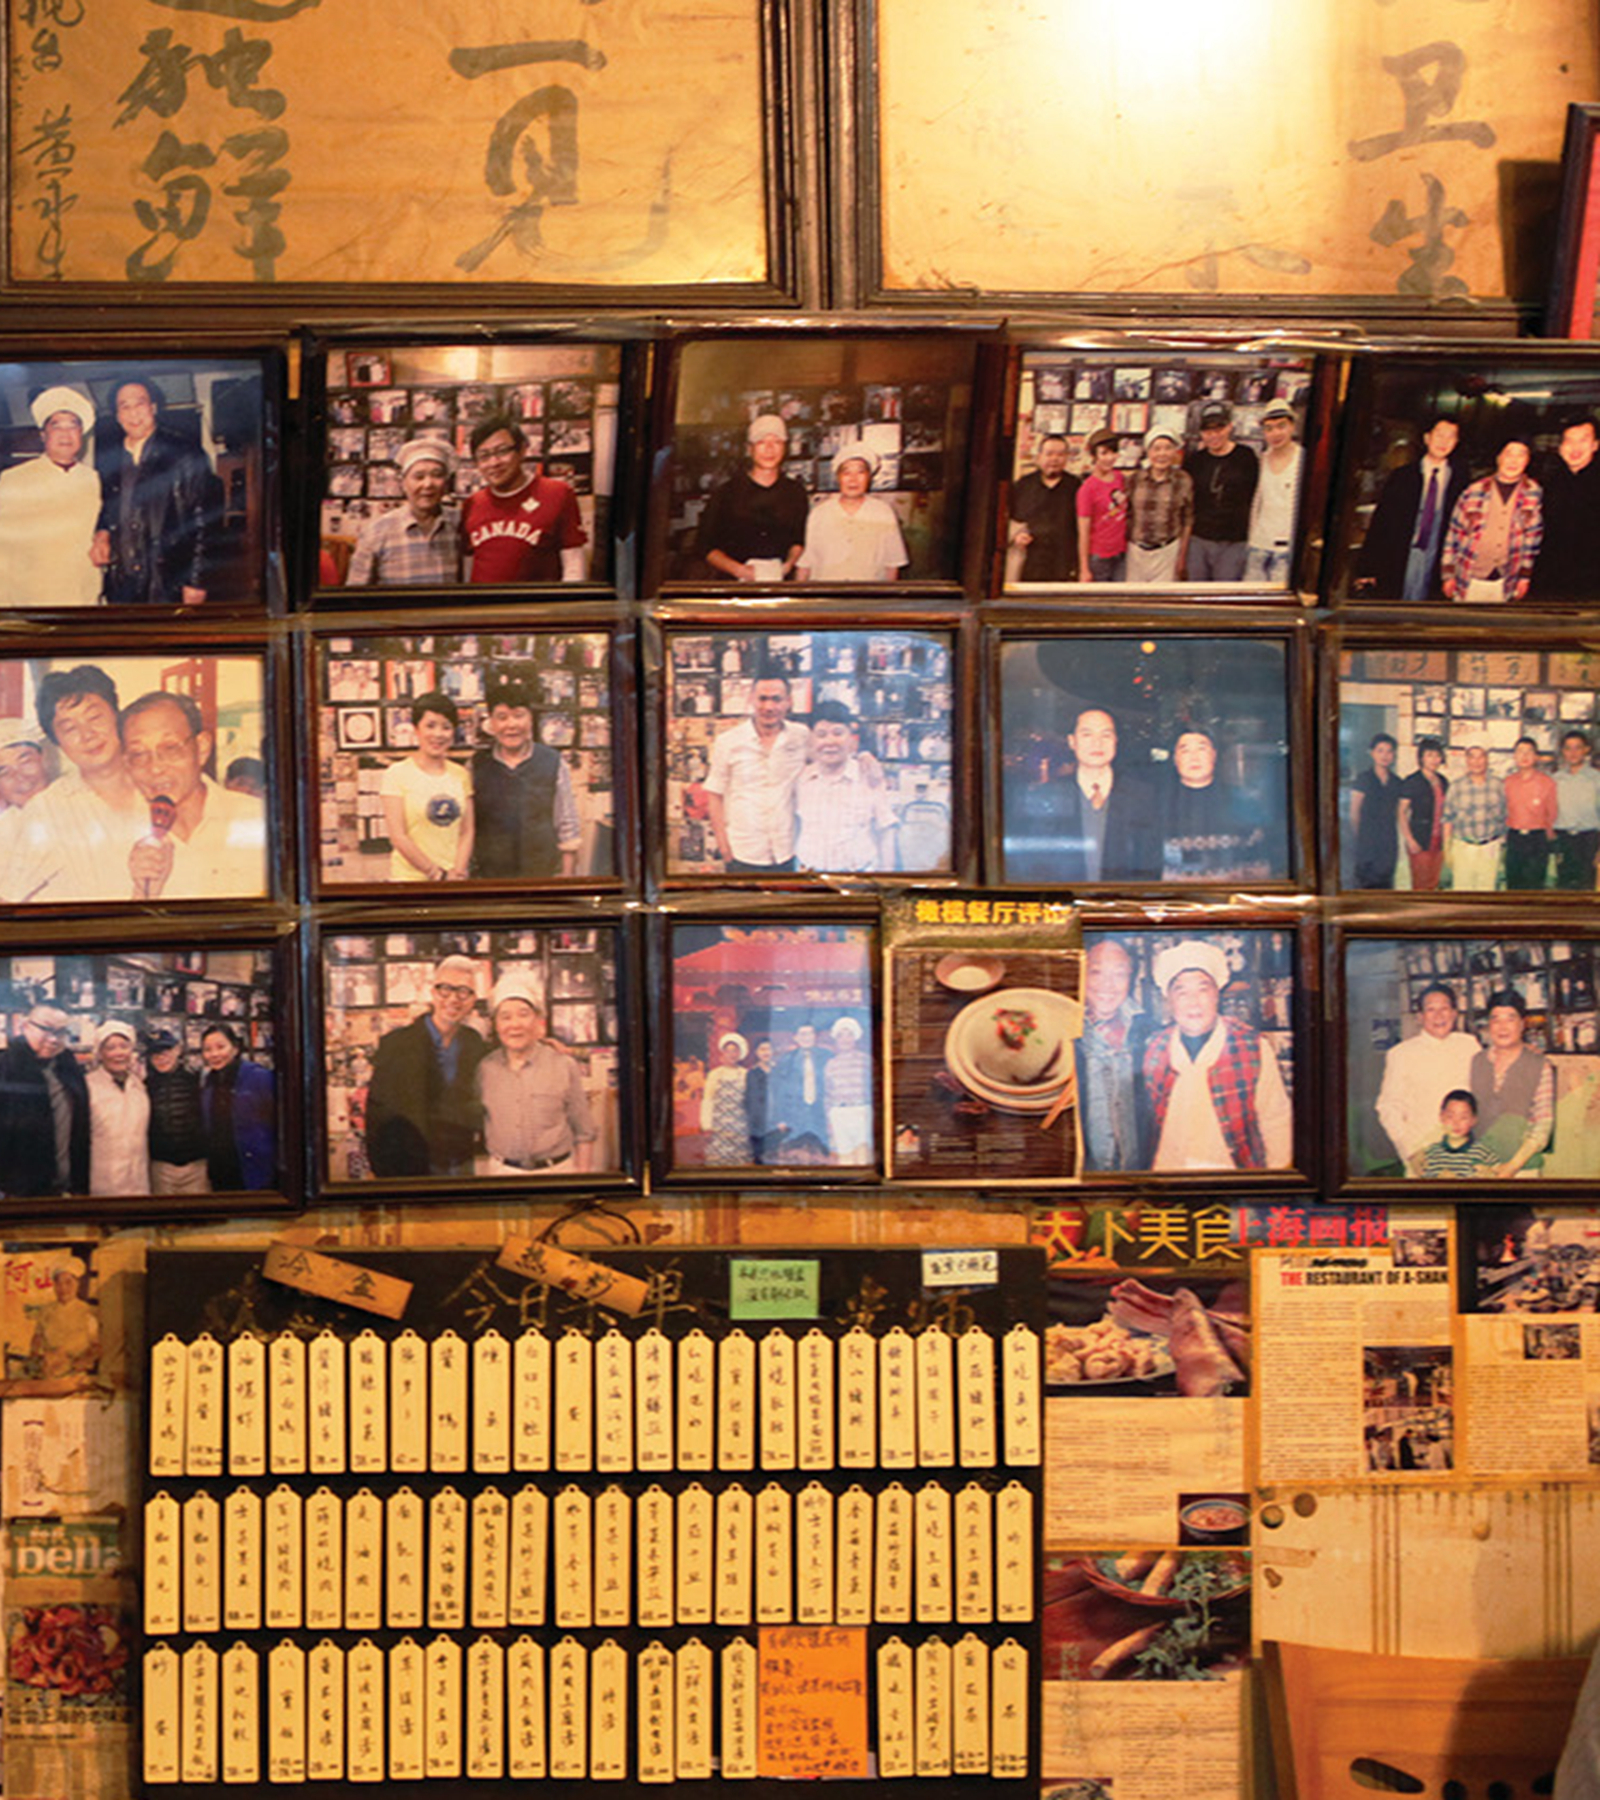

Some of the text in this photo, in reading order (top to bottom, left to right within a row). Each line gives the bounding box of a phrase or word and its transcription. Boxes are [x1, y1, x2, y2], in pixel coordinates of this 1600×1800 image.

[470, 521, 542, 547] CANADA
[1280, 1271, 1303, 1286] THE
[1306, 1271, 1383, 1286] RESTAURANT
[1387, 1271, 1401, 1285] OF
